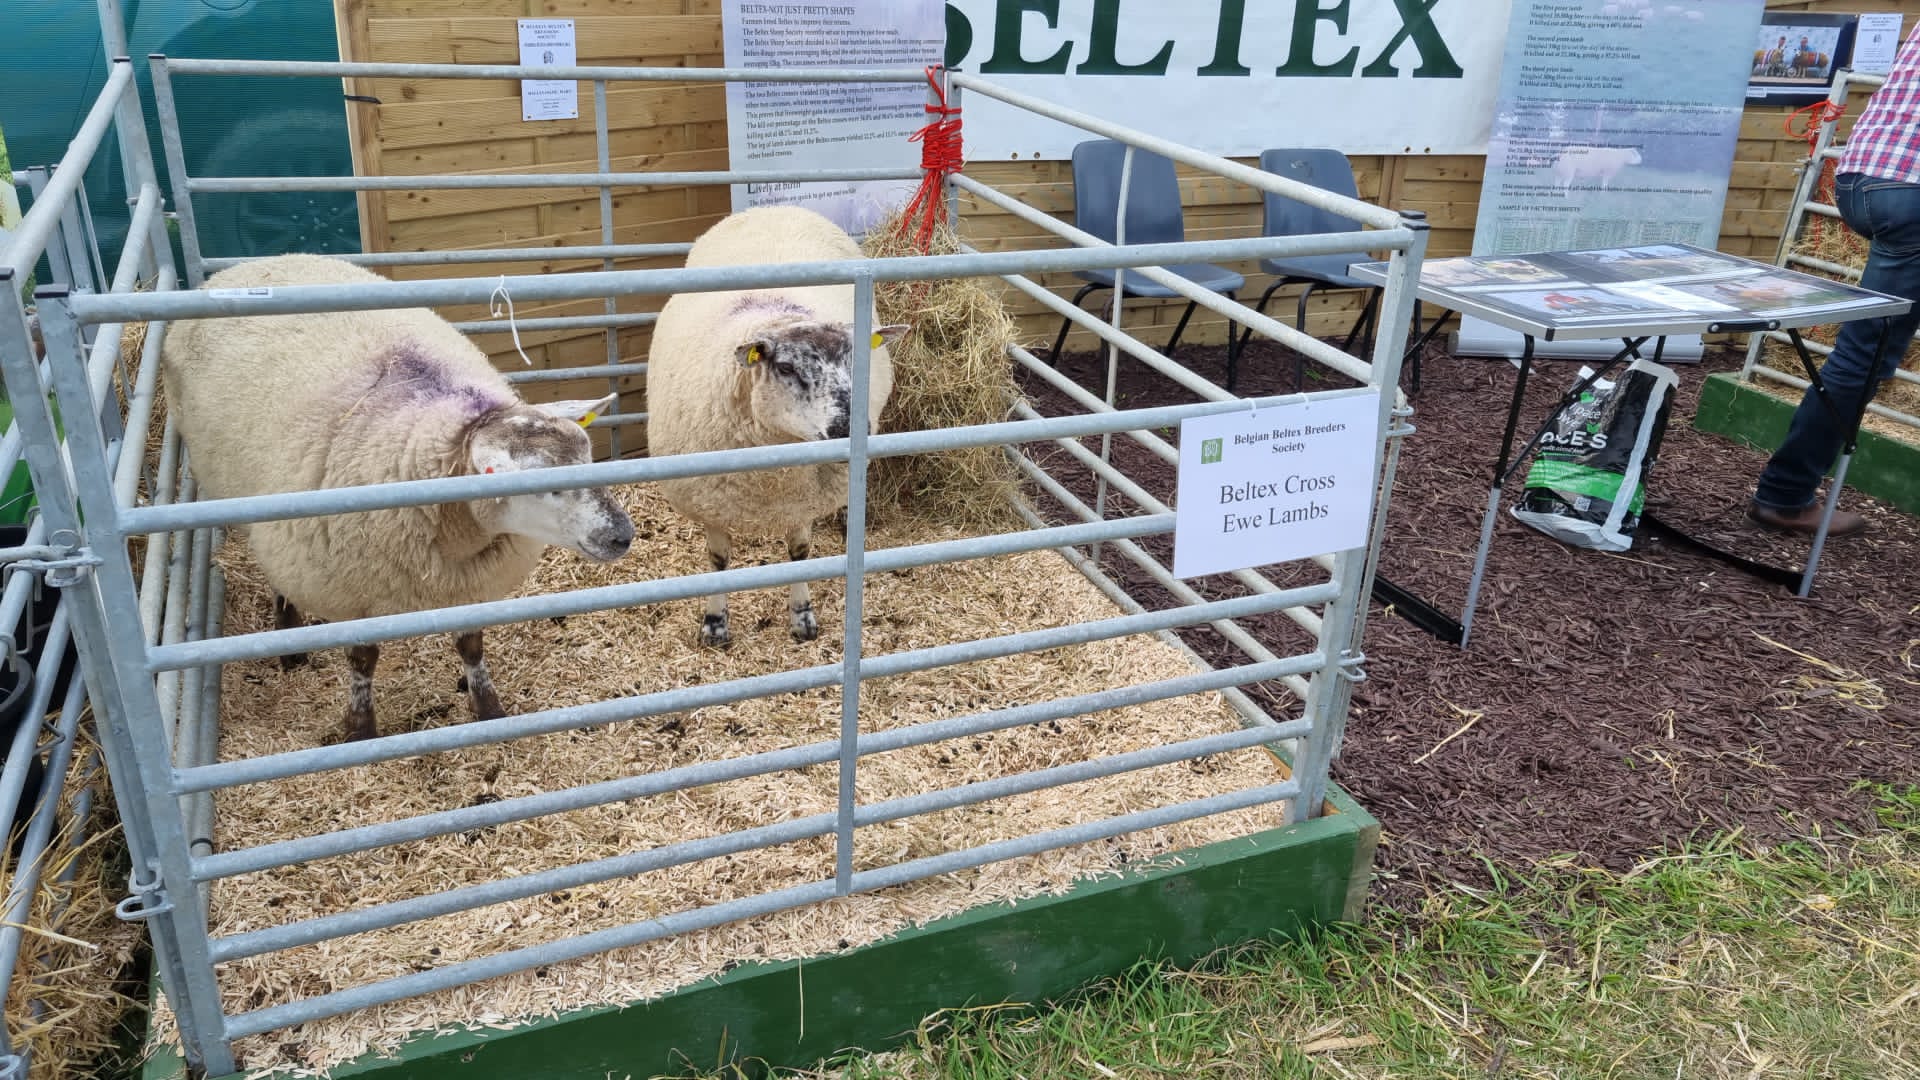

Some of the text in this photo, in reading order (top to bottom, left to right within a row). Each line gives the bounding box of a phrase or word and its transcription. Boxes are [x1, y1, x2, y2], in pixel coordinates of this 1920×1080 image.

[784, 6, 802, 16] JUST
[803, 6, 830, 15] PRETTY
[830, 7, 857, 16] SHAPES
[785, 29, 804, 38] Society
[785, 39, 804, 47] Society
[946, 0, 1464, 78] ELEX
[746, 111, 758, 119] This
[758, 112, 774, 120] proves
[747, 121, 757, 129] The
[746, 131, 764, 140] killing
[747, 142, 758, 150] The
[747, 151, 761, 160] other
[1234, 422, 1347, 445] Belgian Beltex Breeders
[1271, 443, 1306, 455] Society
[1220, 474, 1336, 504] Beltex Cross
[1223, 501, 1329, 533] Ewe Lambs
